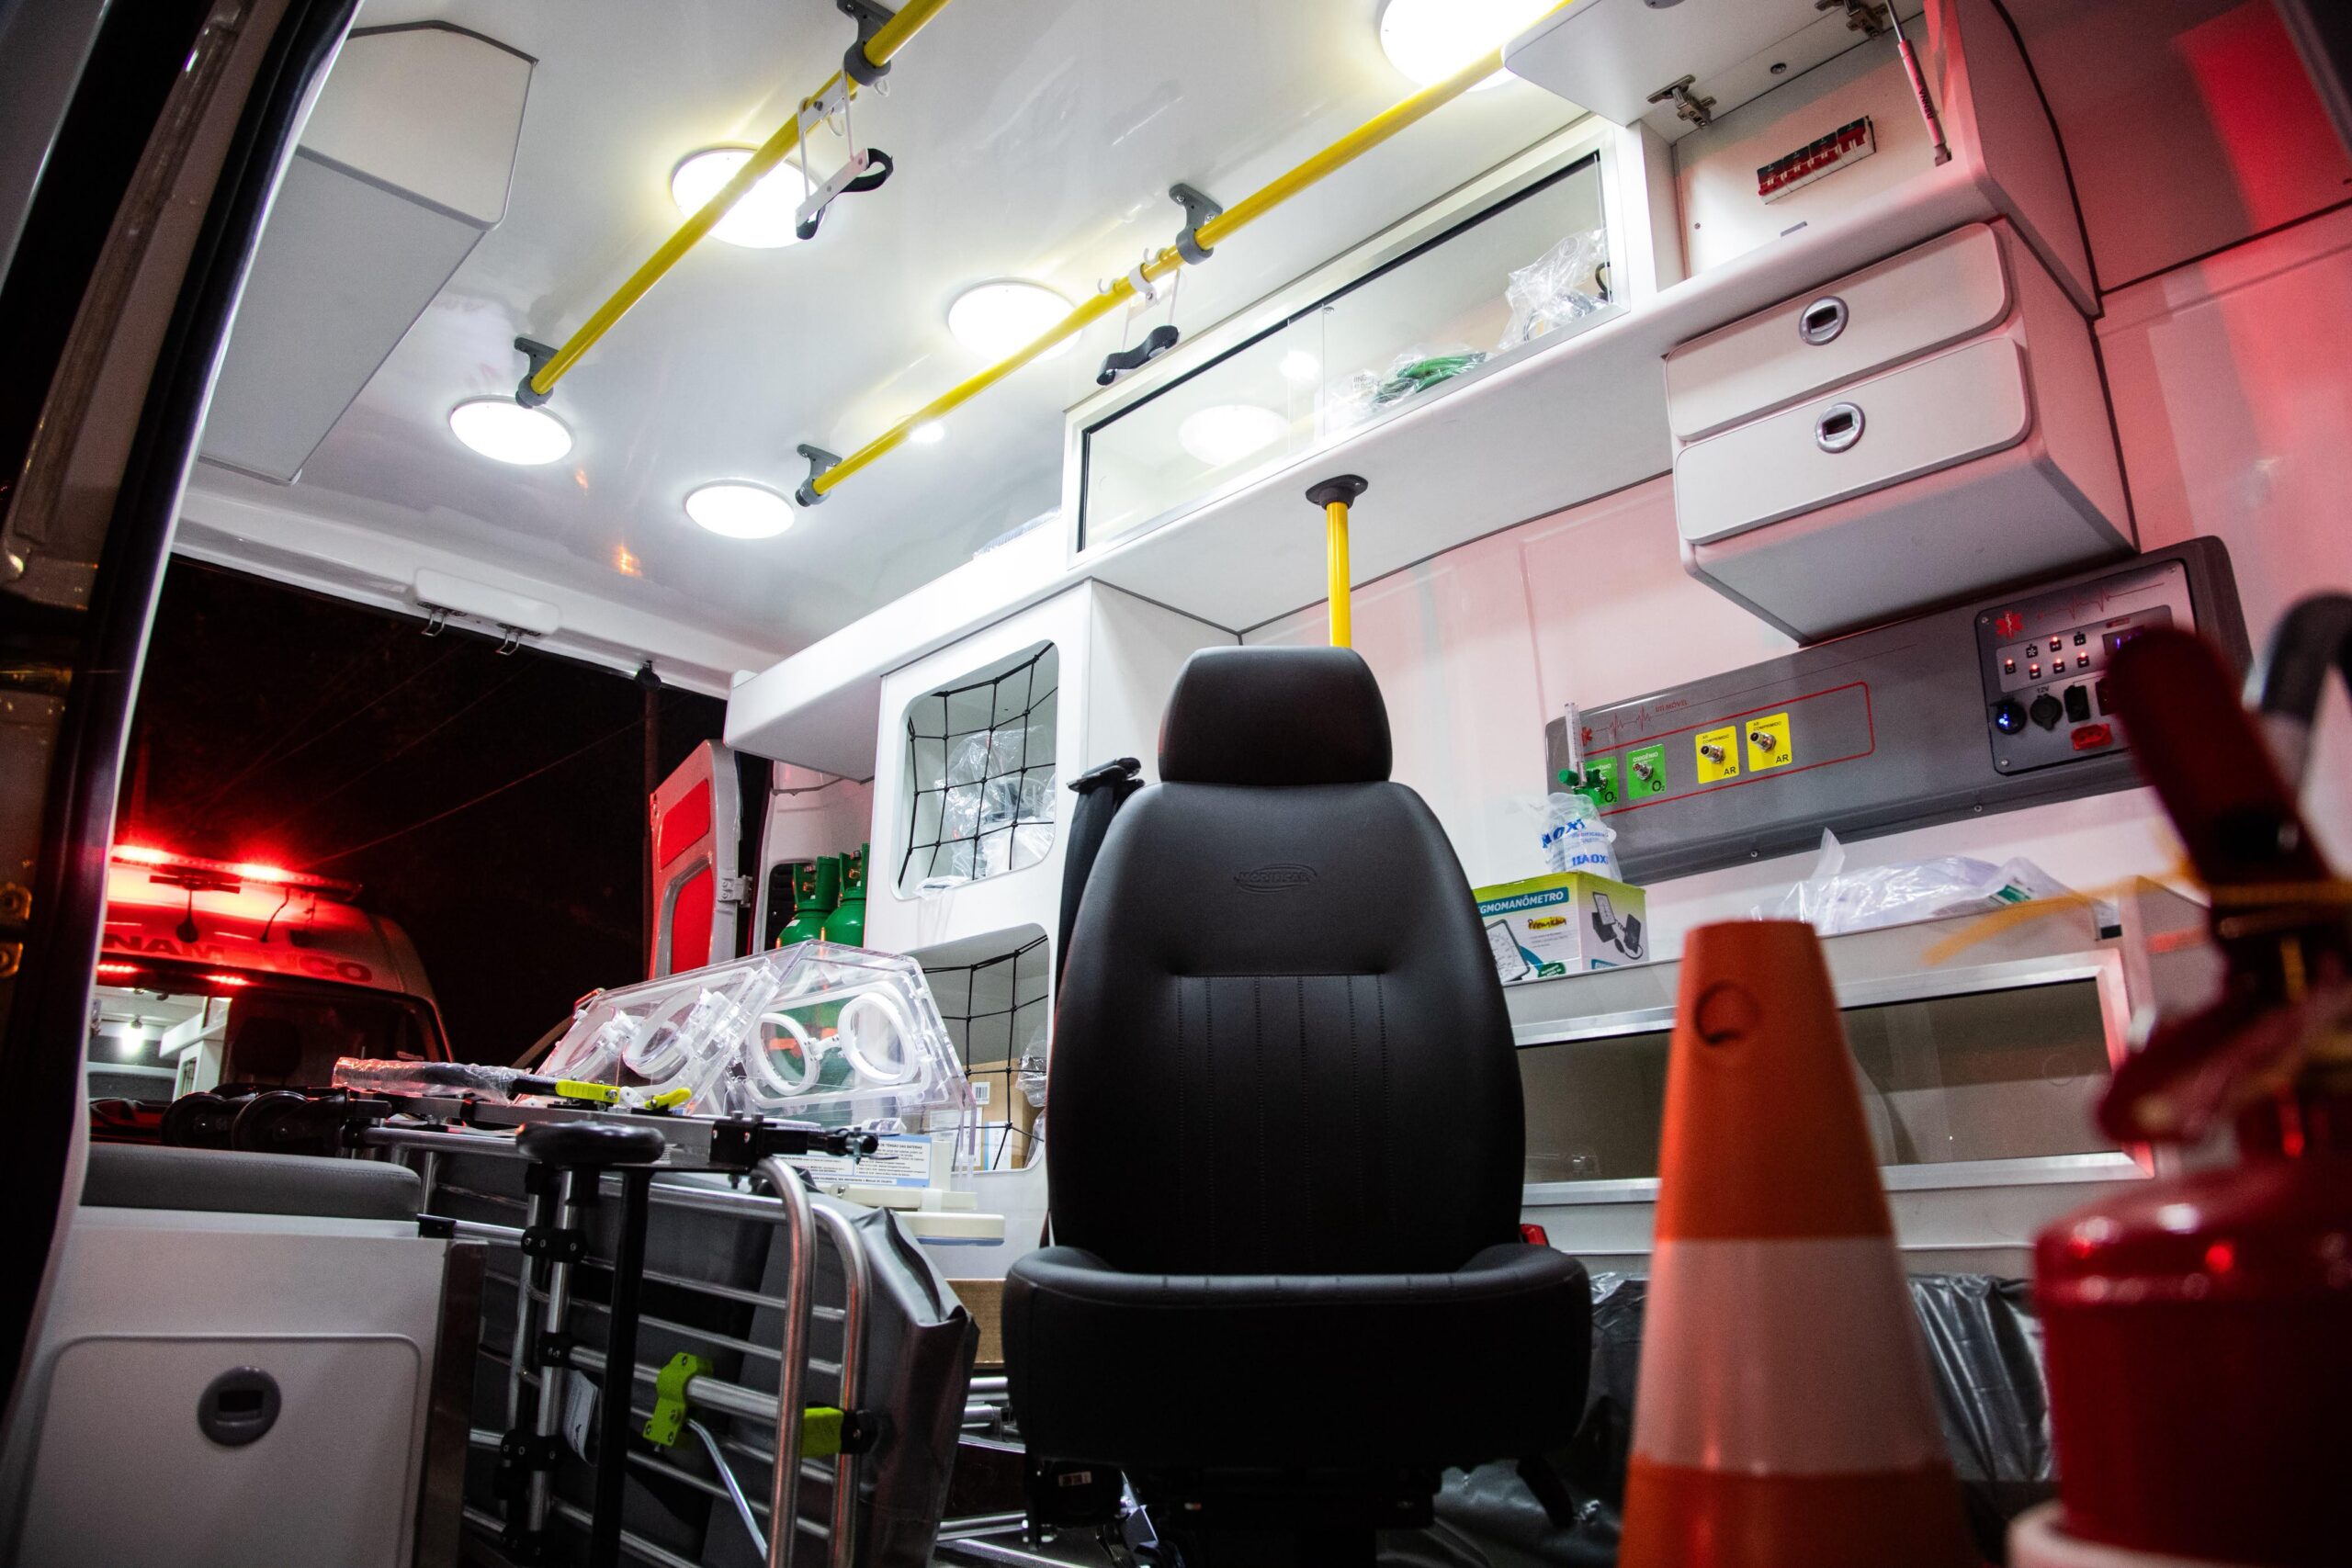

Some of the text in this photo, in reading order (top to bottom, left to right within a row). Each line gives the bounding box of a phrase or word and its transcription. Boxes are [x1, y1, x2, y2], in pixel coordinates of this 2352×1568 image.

[1775, 753, 1789, 764] AR
[1724, 766, 1736, 776] AR
[1479, 890, 1564, 914] GMOMANÔMETRO
